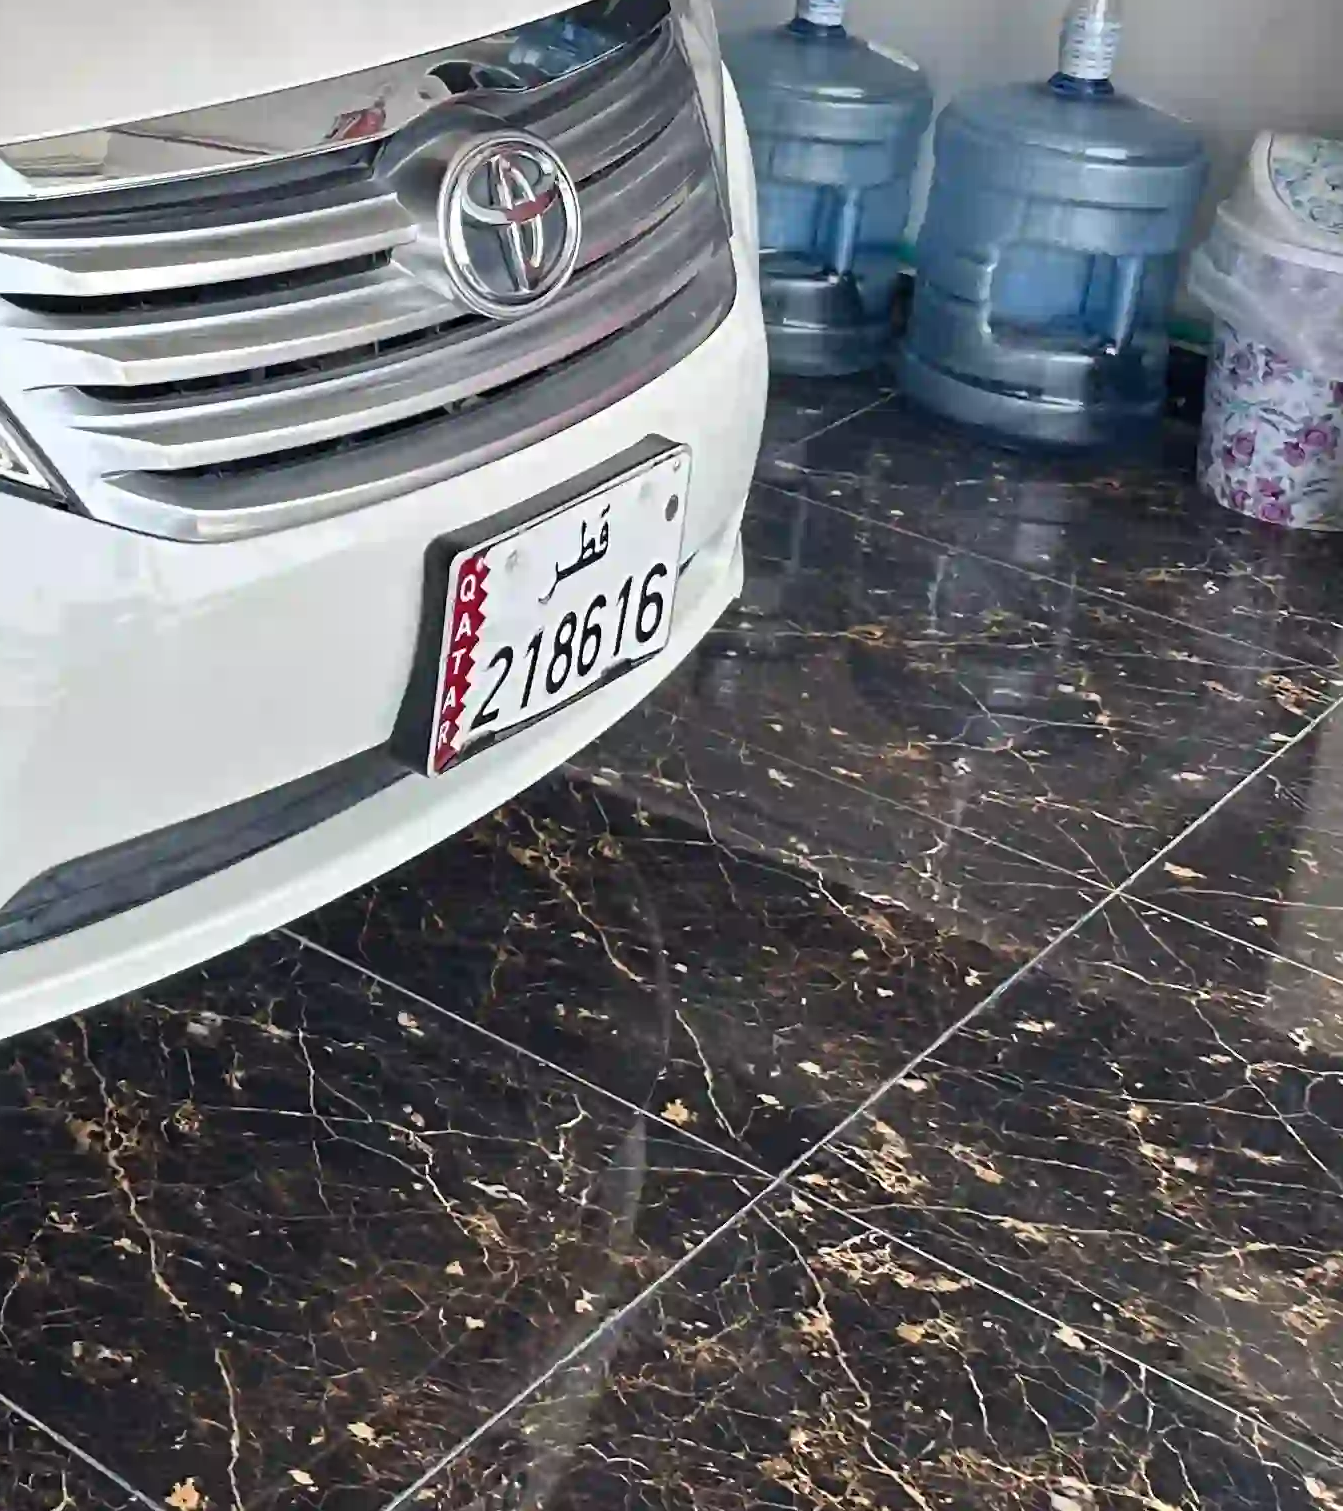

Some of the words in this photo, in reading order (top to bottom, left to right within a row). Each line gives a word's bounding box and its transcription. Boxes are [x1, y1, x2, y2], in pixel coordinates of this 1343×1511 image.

[537, 503, 611, 605] قطر
[437, 574, 477, 746] QATAR
[470, 562, 669, 732] 218616
